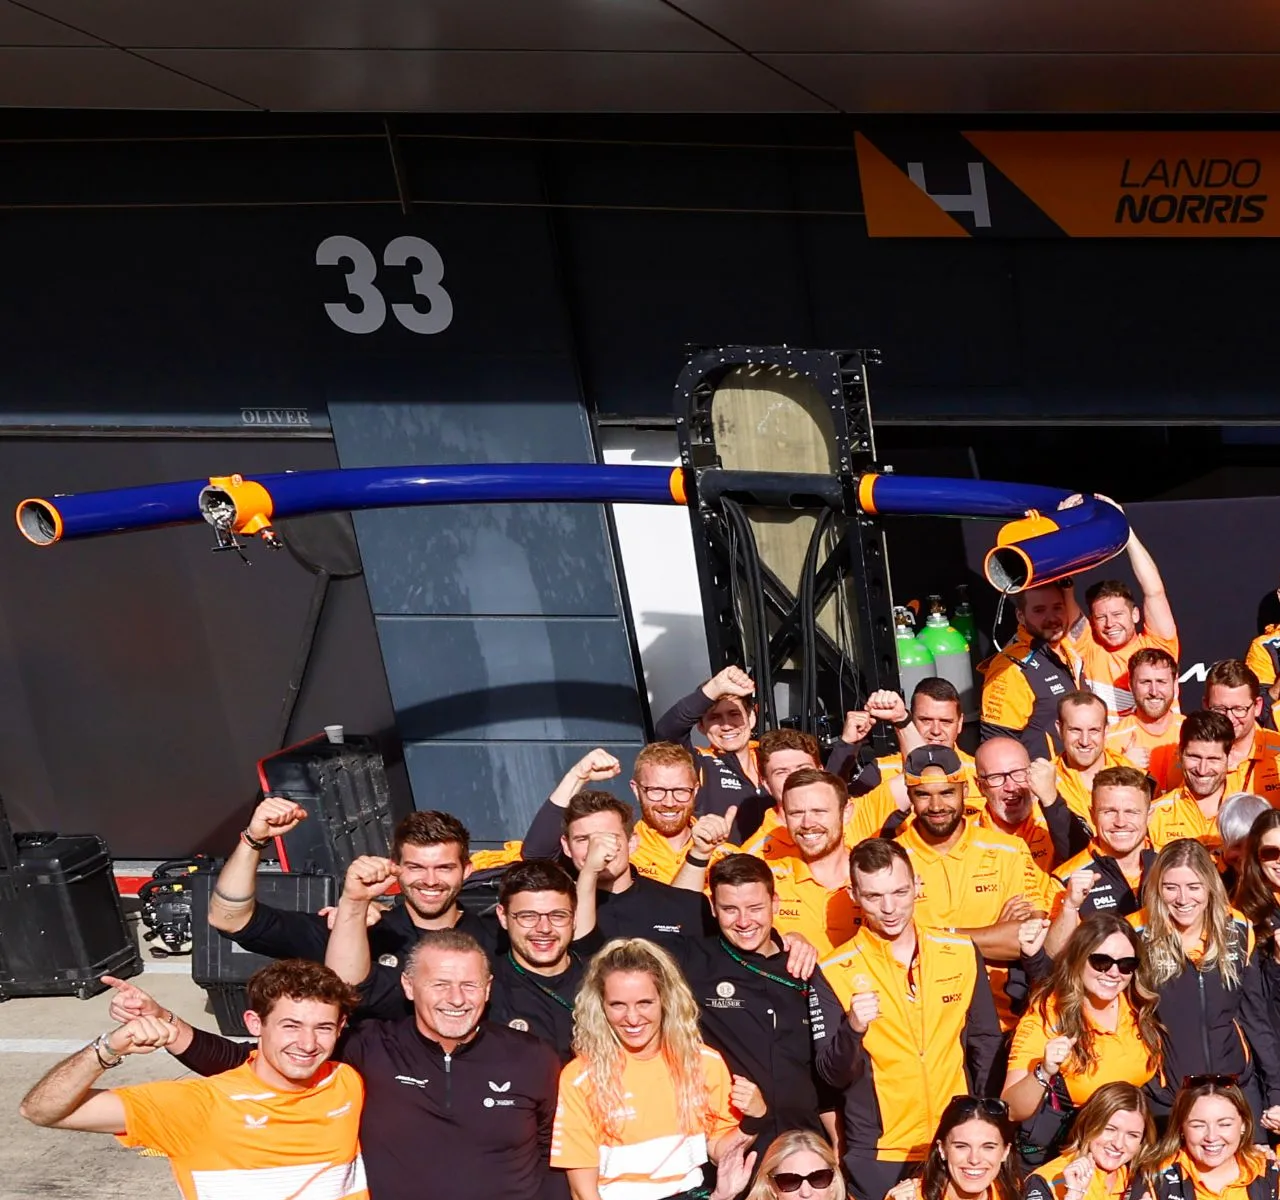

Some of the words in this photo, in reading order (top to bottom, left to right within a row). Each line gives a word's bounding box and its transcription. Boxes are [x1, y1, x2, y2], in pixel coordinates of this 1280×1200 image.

[1118, 159, 1261, 188] LANDO
[1114, 194, 1267, 224] NORRIS
[315, 235, 454, 335] 33
[241, 410, 310, 424] OLIVER
